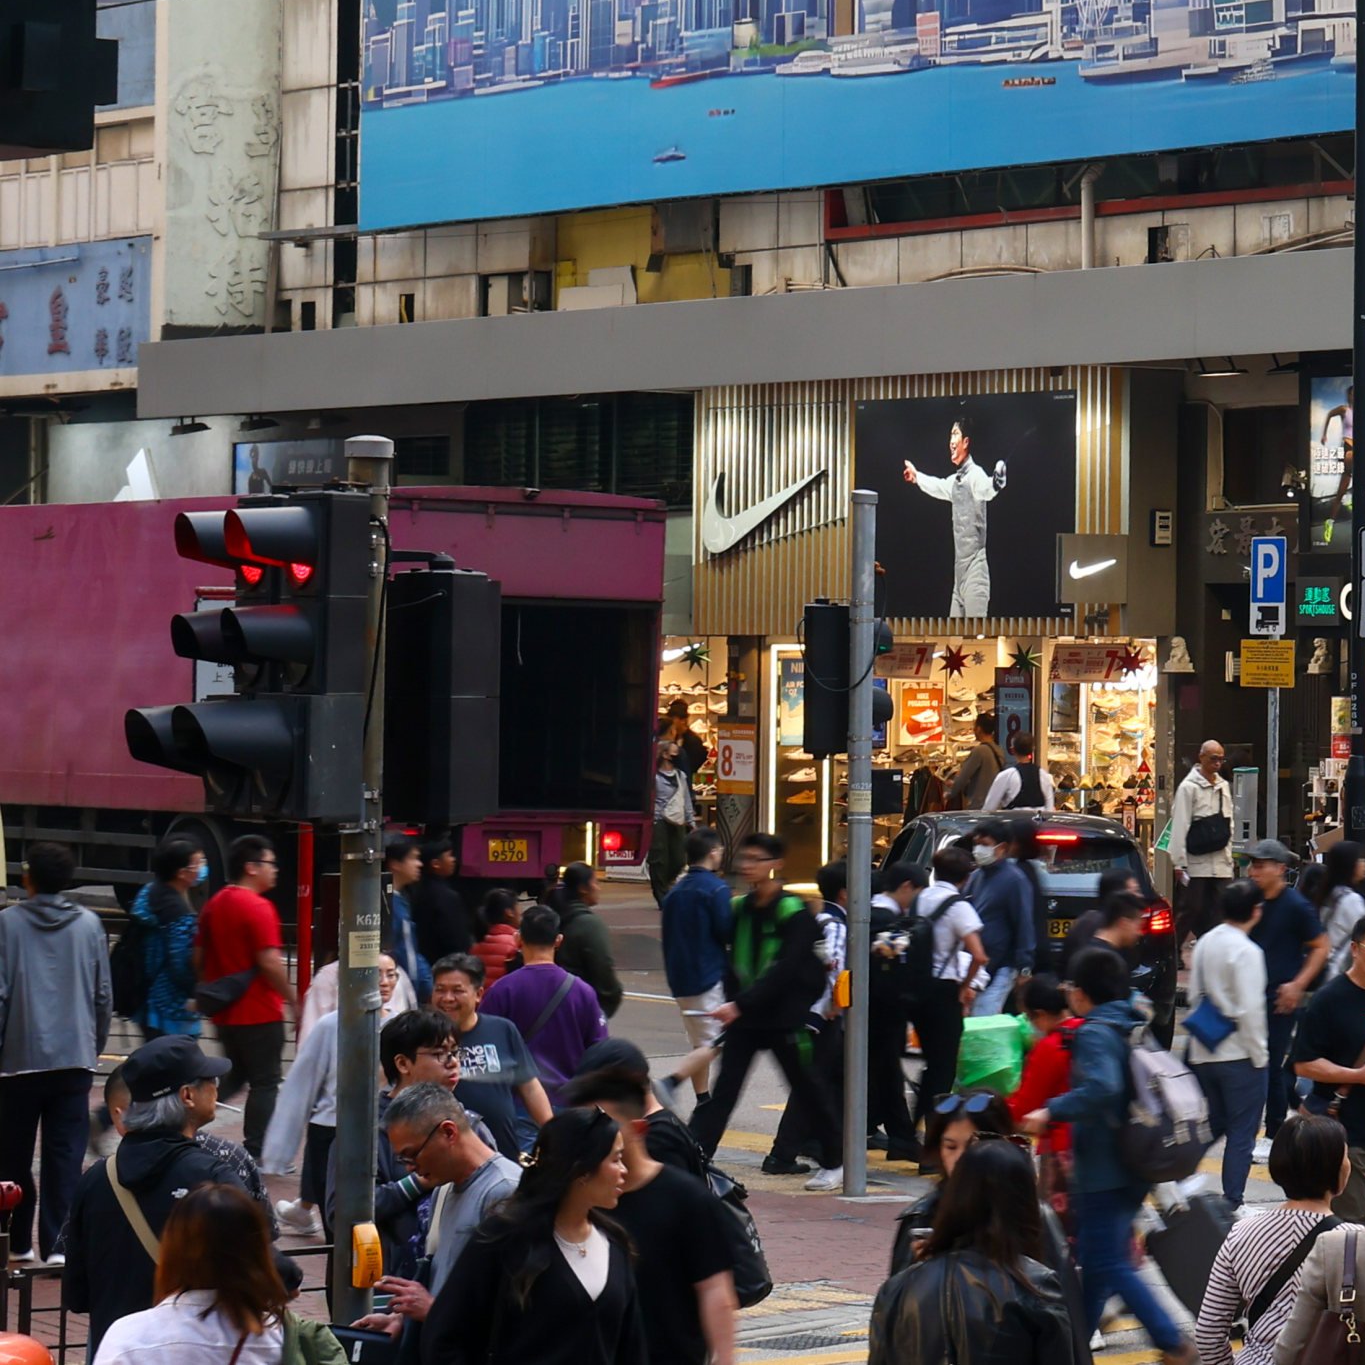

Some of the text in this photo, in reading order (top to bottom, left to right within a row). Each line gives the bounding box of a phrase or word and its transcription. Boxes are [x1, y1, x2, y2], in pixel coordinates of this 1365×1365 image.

[1256, 543, 1280, 599] P
[501, 840, 516, 851] TD
[492, 850, 524, 861] 9570
